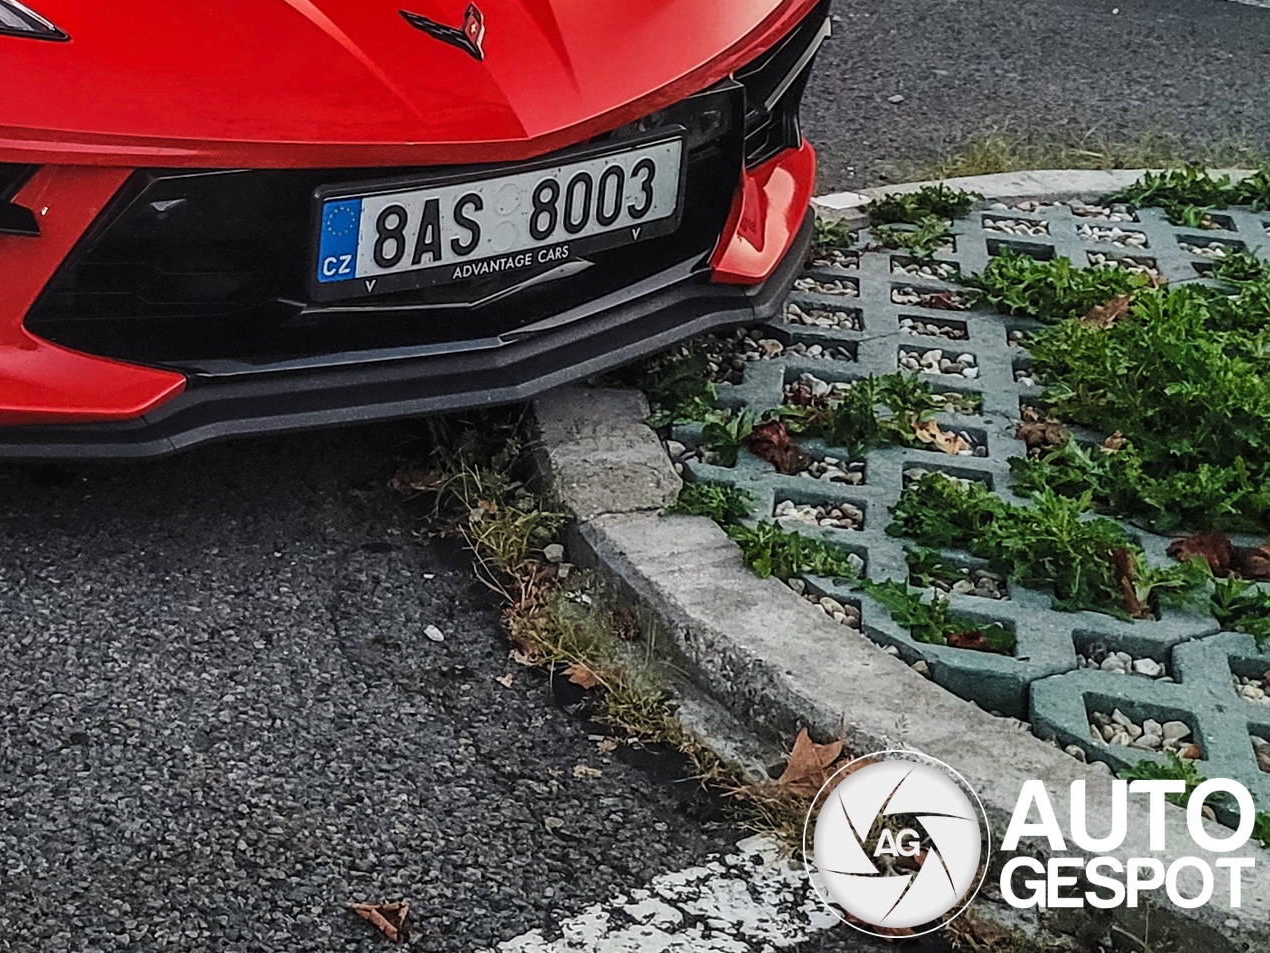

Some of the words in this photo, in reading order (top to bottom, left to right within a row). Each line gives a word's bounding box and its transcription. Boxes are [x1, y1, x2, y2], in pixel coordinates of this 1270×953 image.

[372, 192, 484, 268] 8AS
[528, 157, 656, 242] 8003
[322, 254, 352, 277] CZ
[452, 252, 533, 280] ADVANTAGE
[537, 245, 570, 264] CARS
